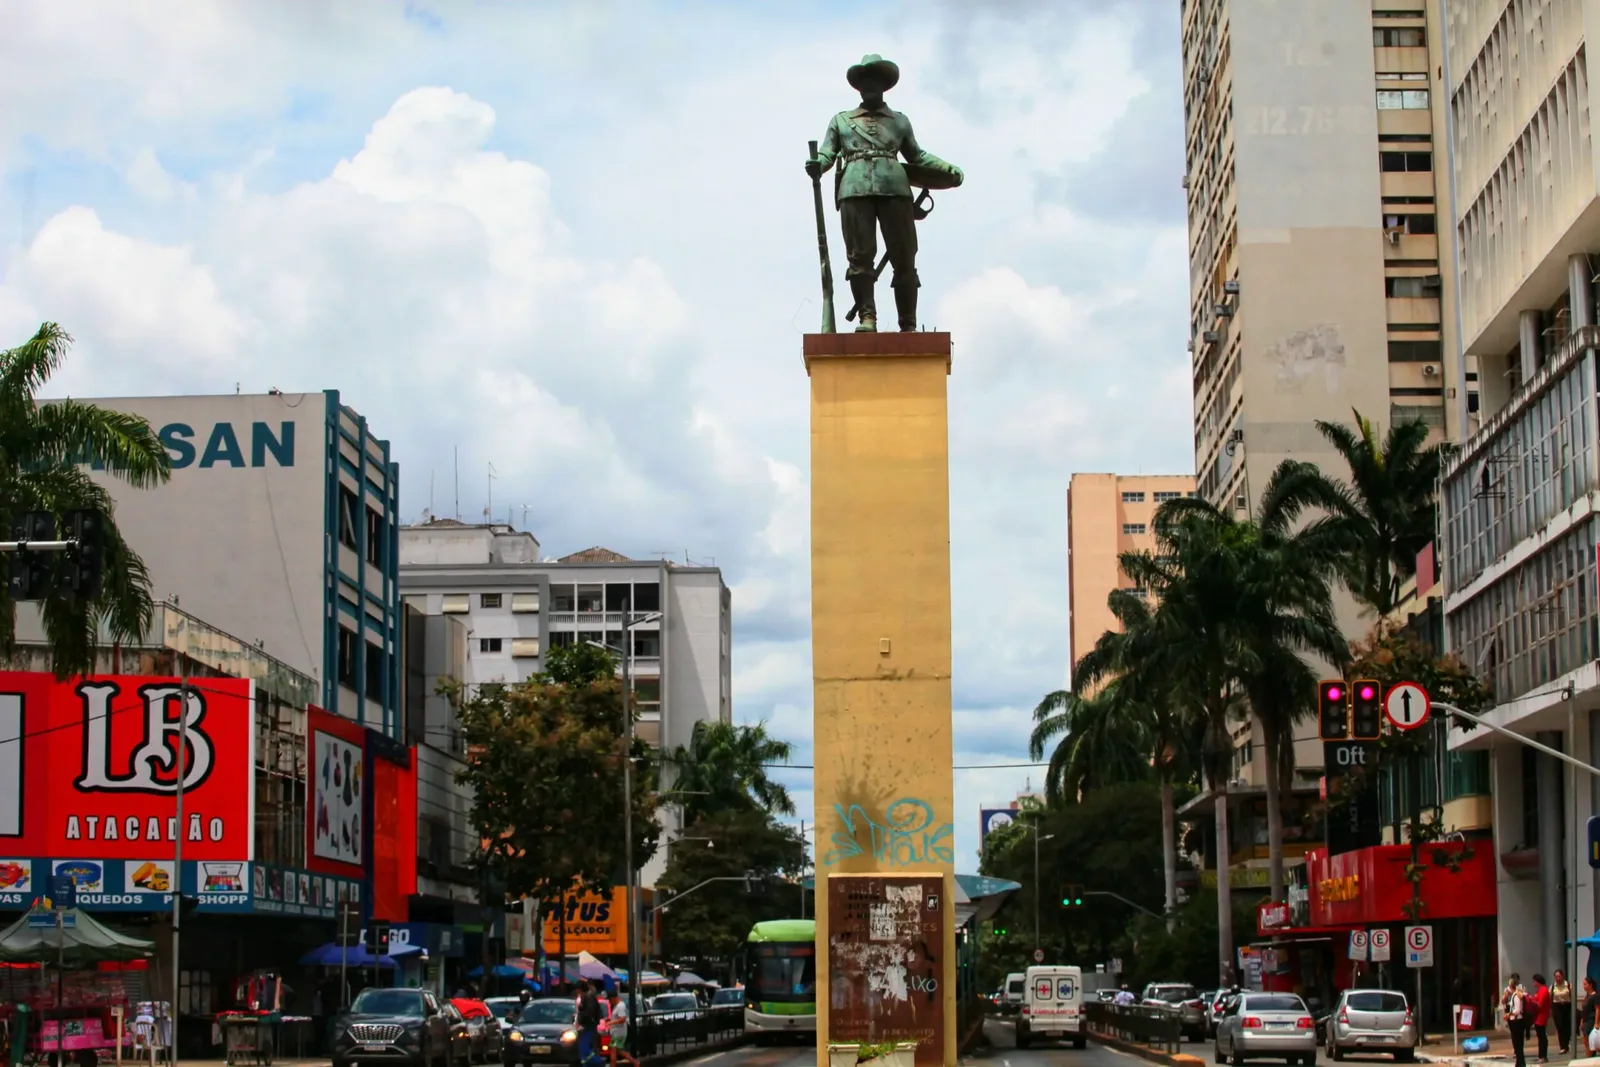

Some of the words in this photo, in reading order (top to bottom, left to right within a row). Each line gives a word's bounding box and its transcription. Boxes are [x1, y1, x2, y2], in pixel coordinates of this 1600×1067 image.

[65, 813, 225, 842] ATACADÃO
[75, 894, 143, 904] QUEDOS
[198, 894, 248, 905] SHOPP
[552, 926, 611, 937] CLÇADOS
[1357, 934, 1363, 945] E
[1377, 933, 1384, 944] E
[1415, 932, 1423, 946] E
